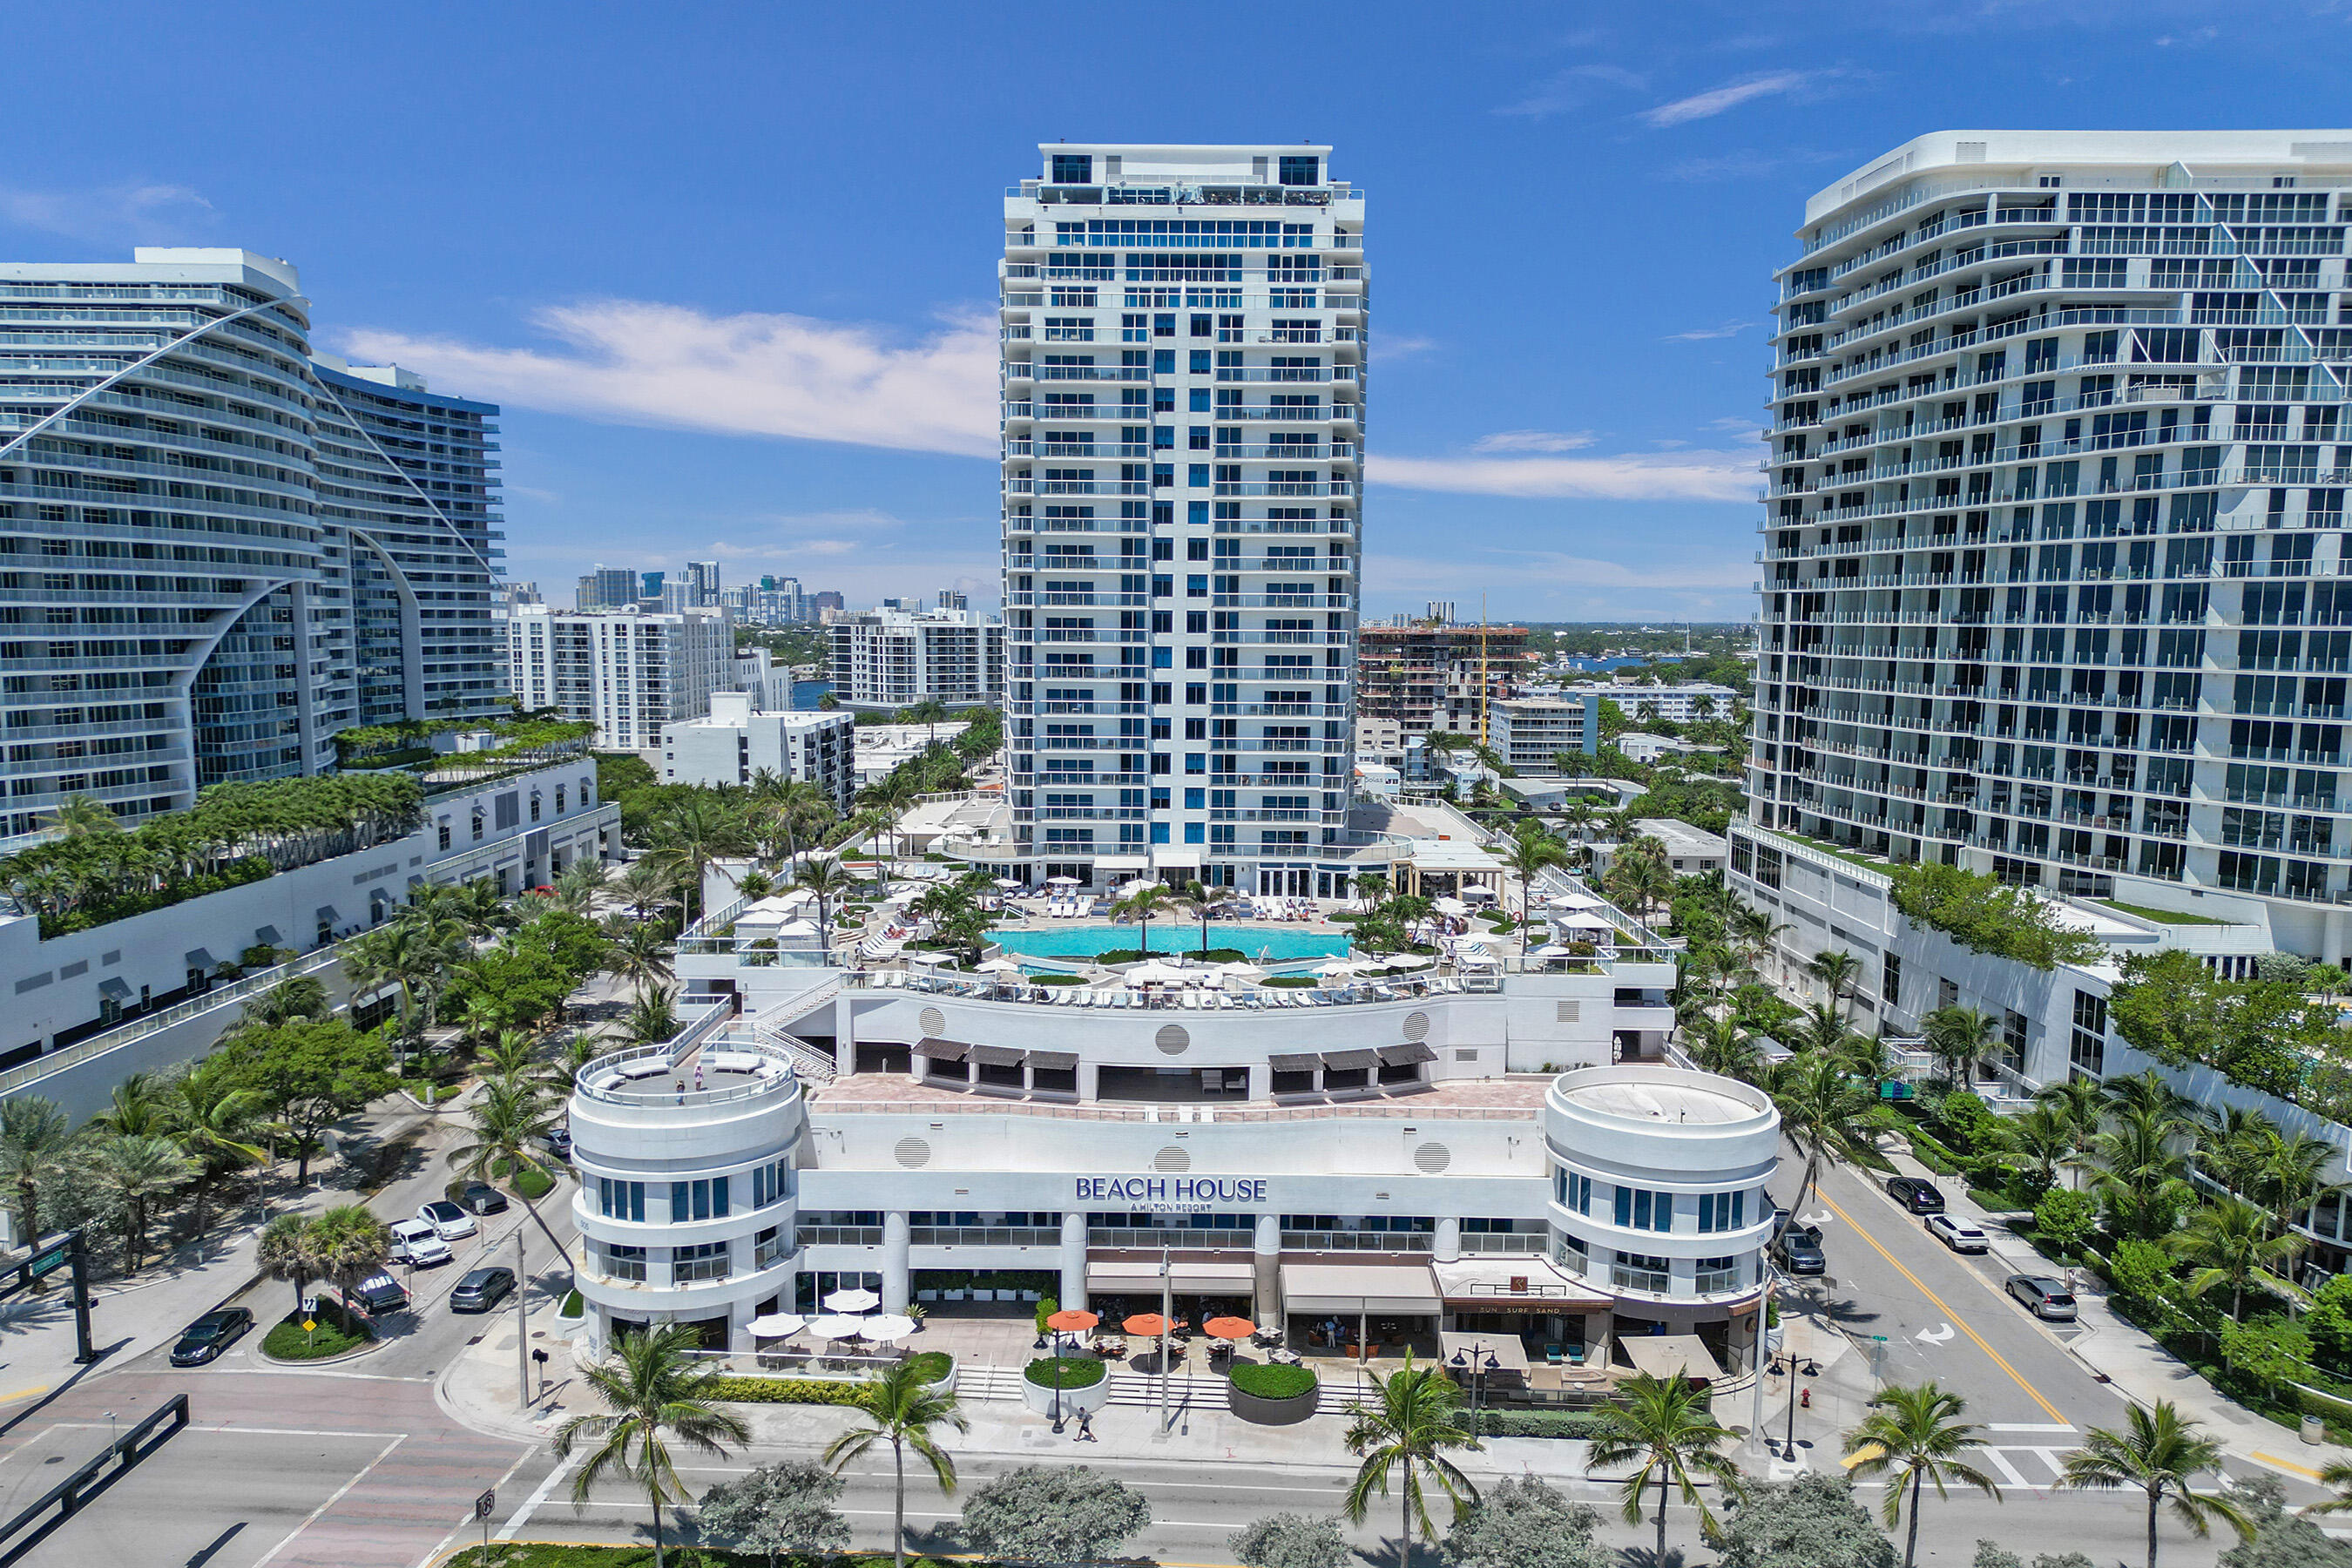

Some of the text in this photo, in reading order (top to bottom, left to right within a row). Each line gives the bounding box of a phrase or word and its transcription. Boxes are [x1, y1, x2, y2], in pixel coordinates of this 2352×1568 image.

[1077, 1178, 1267, 1201] BEACH HOUSE
[1131, 1203, 1212, 1213] A HILTON RESORT
